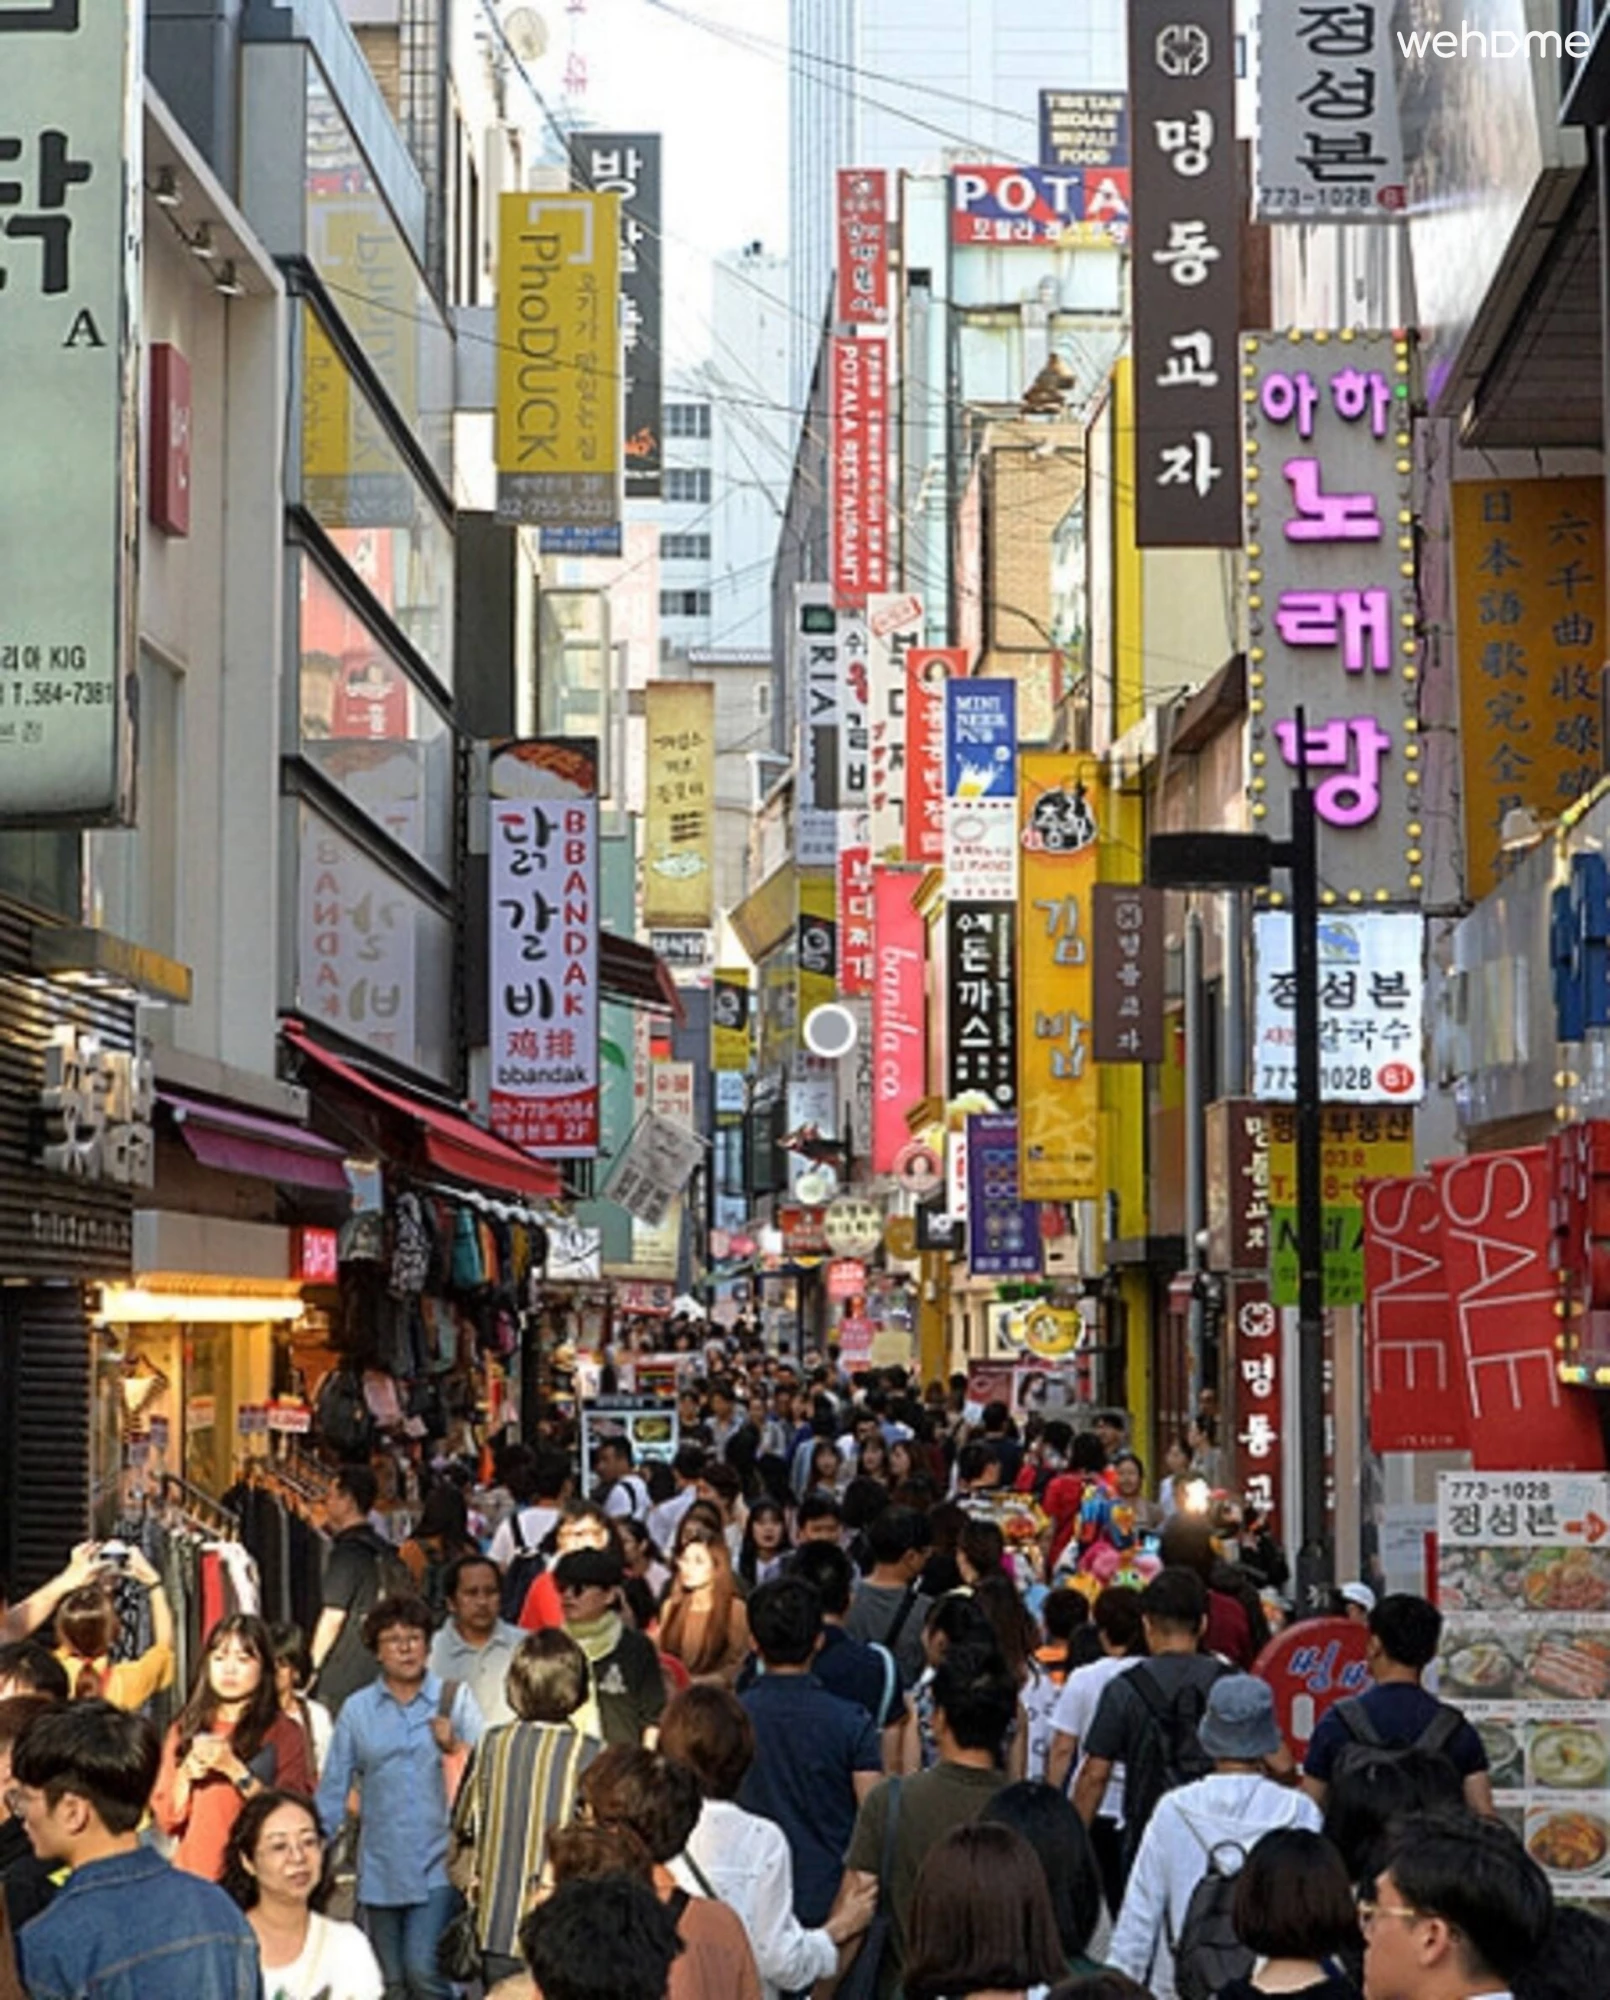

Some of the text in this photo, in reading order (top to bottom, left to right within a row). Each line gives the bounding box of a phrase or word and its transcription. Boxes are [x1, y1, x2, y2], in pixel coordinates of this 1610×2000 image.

[1296, 3, 1387, 182] 정성본
[63, 308, 106, 347] A
[1153, 110, 1222, 498] 명동교자
[1261, 365, 1392, 440] 아하
[50, 645, 87, 671] KIG
[1272, 456, 1392, 828] 노래방
[497, 806, 559, 1020] 닭갈비
[563, 809, 588, 1018] BBANDAK
[959, 936, 993, 1048] 돈까스
[497, 1063, 590, 1085] bbandak
[1369, 1178, 1450, 1394] SALE
[1442, 1156, 1558, 1419] SALE
[1448, 1503, 1558, 1538] 정성본
[1450, 1481, 1552, 1500] 773-1028
